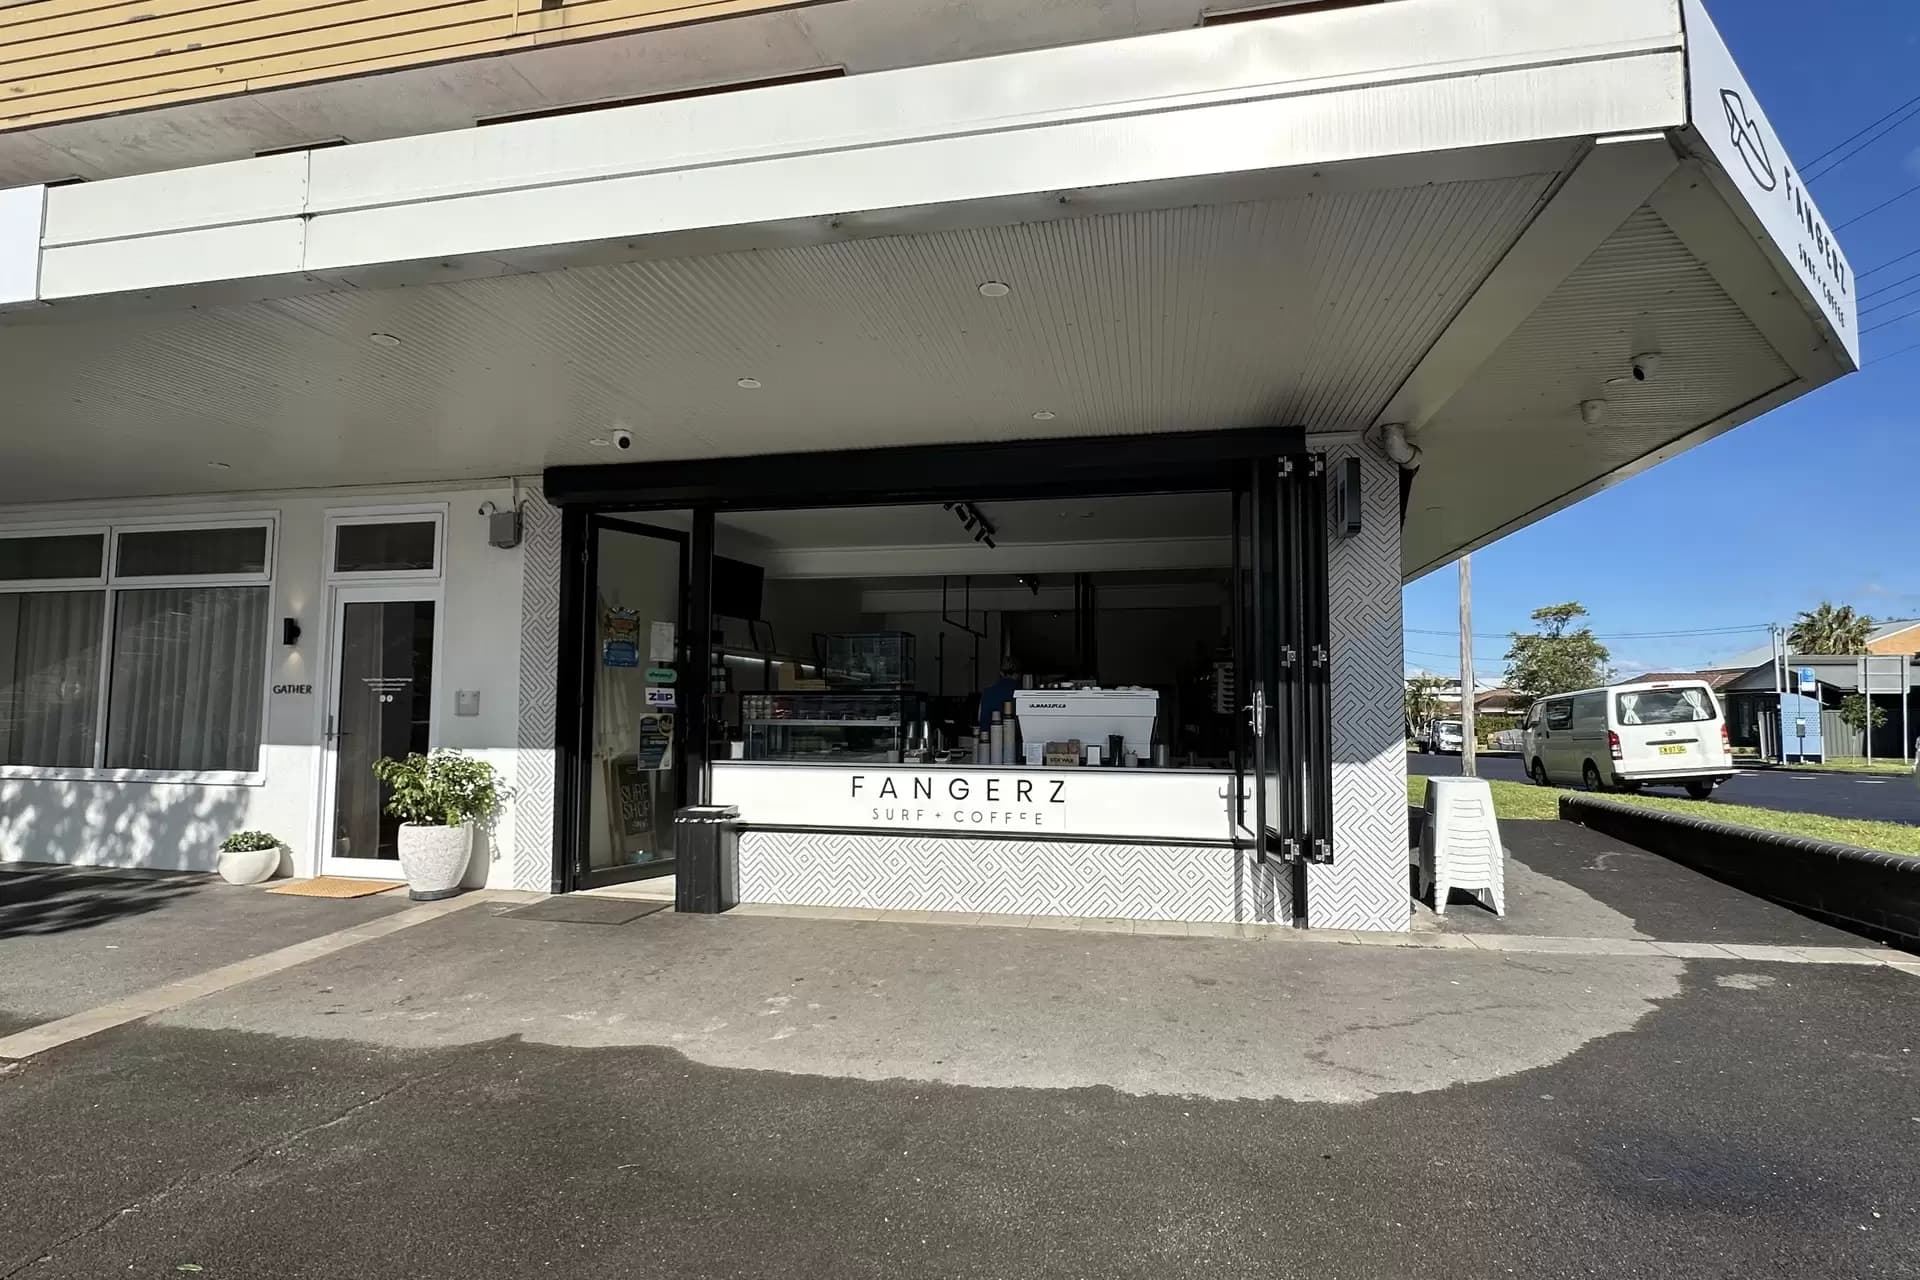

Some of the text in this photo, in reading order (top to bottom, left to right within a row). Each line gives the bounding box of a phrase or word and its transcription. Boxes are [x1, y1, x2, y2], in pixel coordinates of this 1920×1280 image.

[1784, 165, 1846, 295] FANGERZ
[1798, 242, 1816, 280] SURF
[1822, 282, 1845, 328] COFFEE
[272, 684, 312, 694] GATHER
[620, 782, 648, 801] SURF
[851, 776, 1063, 803] FANGERZ
[622, 800, 649, 820] SHOP
[872, 808, 924, 821] SURF
[953, 810, 1041, 825] COFFEE
